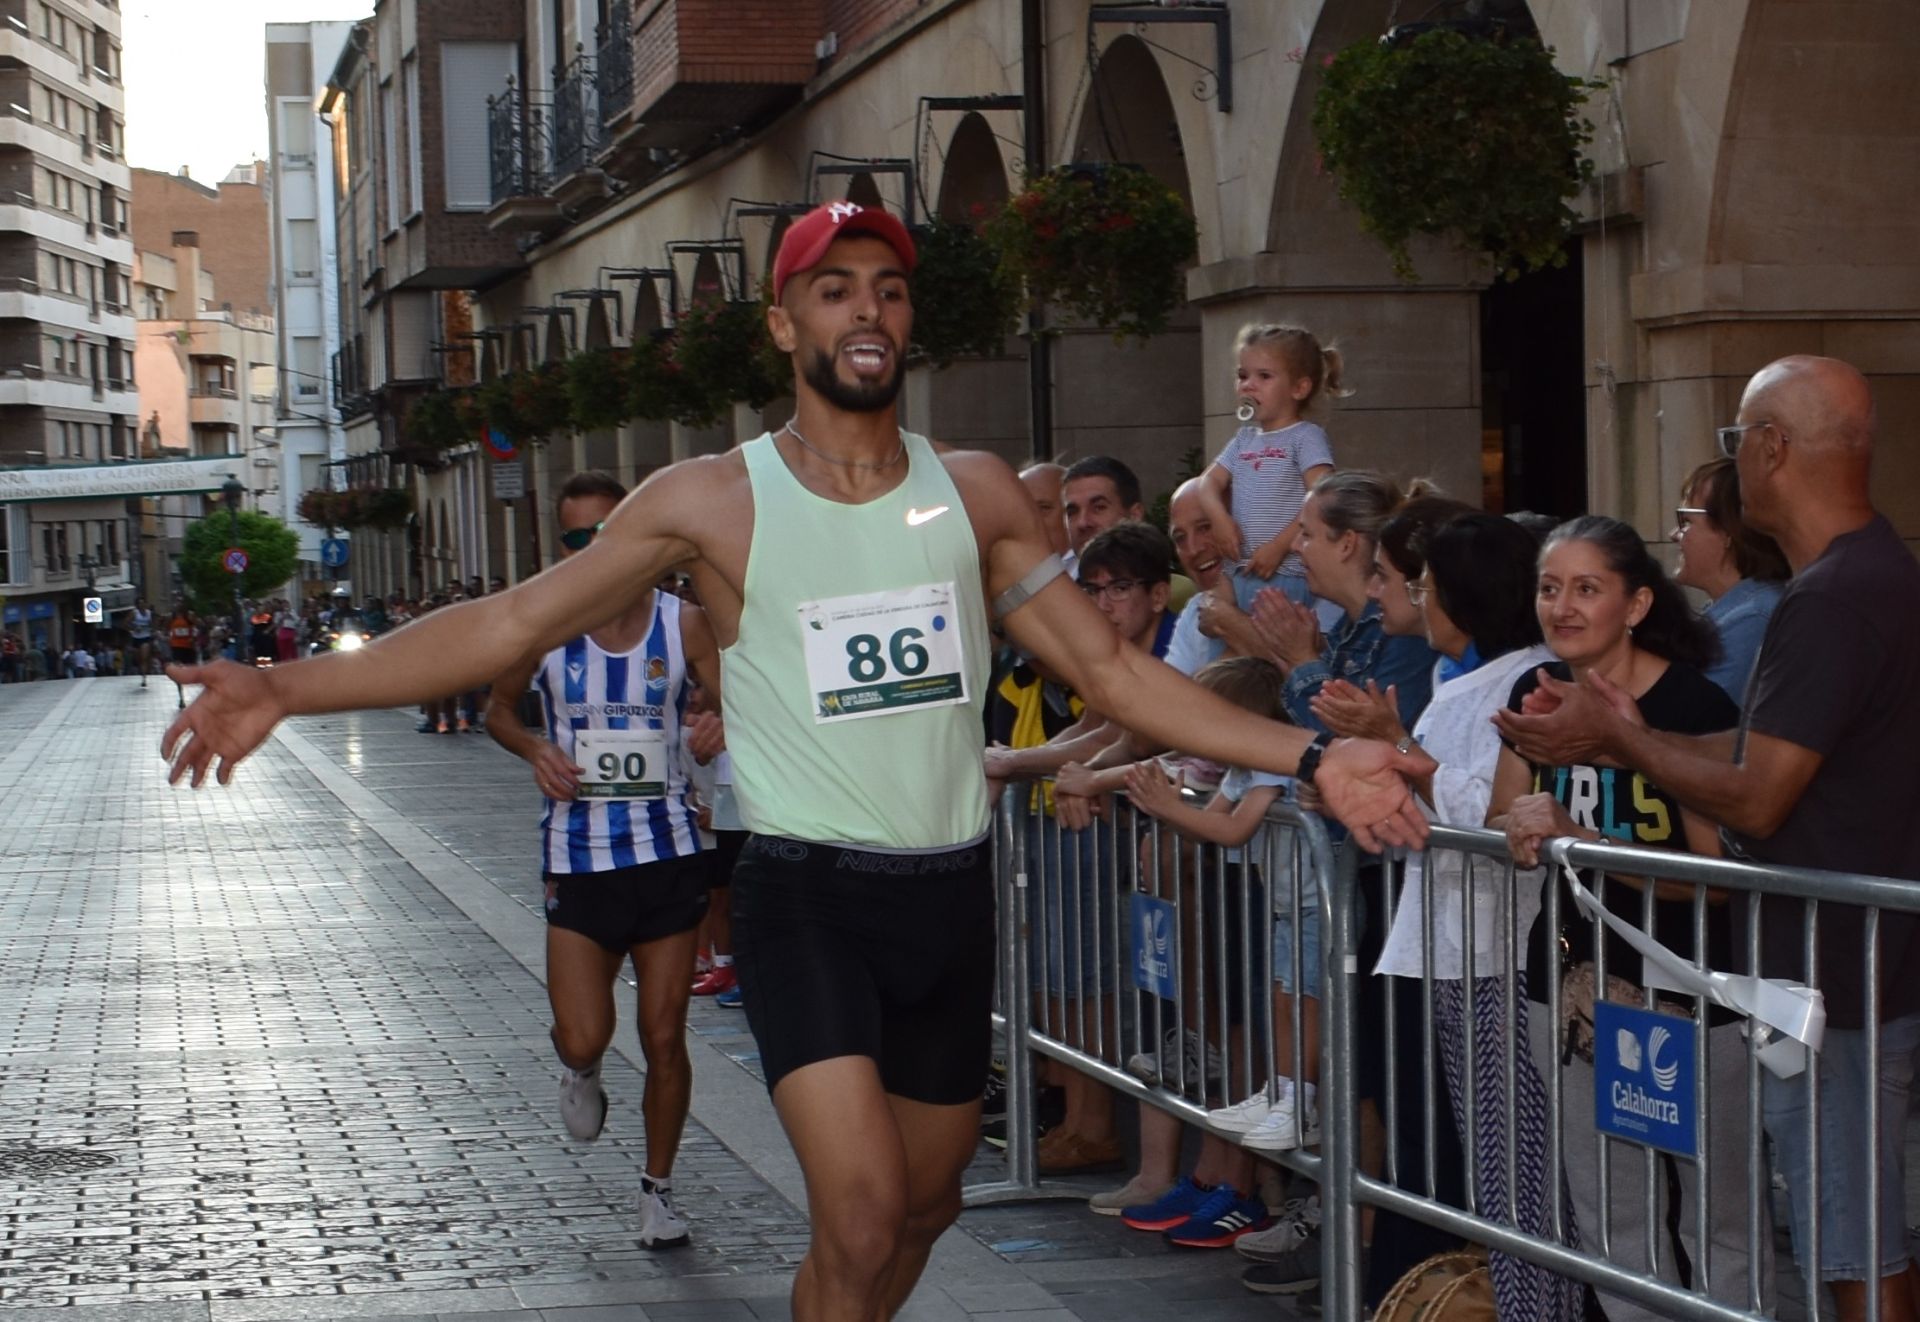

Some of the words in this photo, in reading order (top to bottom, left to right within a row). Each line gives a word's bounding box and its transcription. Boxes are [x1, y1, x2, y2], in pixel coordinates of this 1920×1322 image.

[95, 464, 195, 480] CALAHORRA
[61, 485, 86, 495] DEL
[87, 481, 141, 494] MUNDO
[143, 478, 196, 491] ENTERO
[846, 627, 930, 683] 86
[603, 704, 664, 718] GIPUZKOA
[597, 752, 647, 782] 90
[836, 851, 915, 875] NIKE
[919, 850, 978, 875] PRO
[1612, 1080, 1680, 1125] Calahorra
